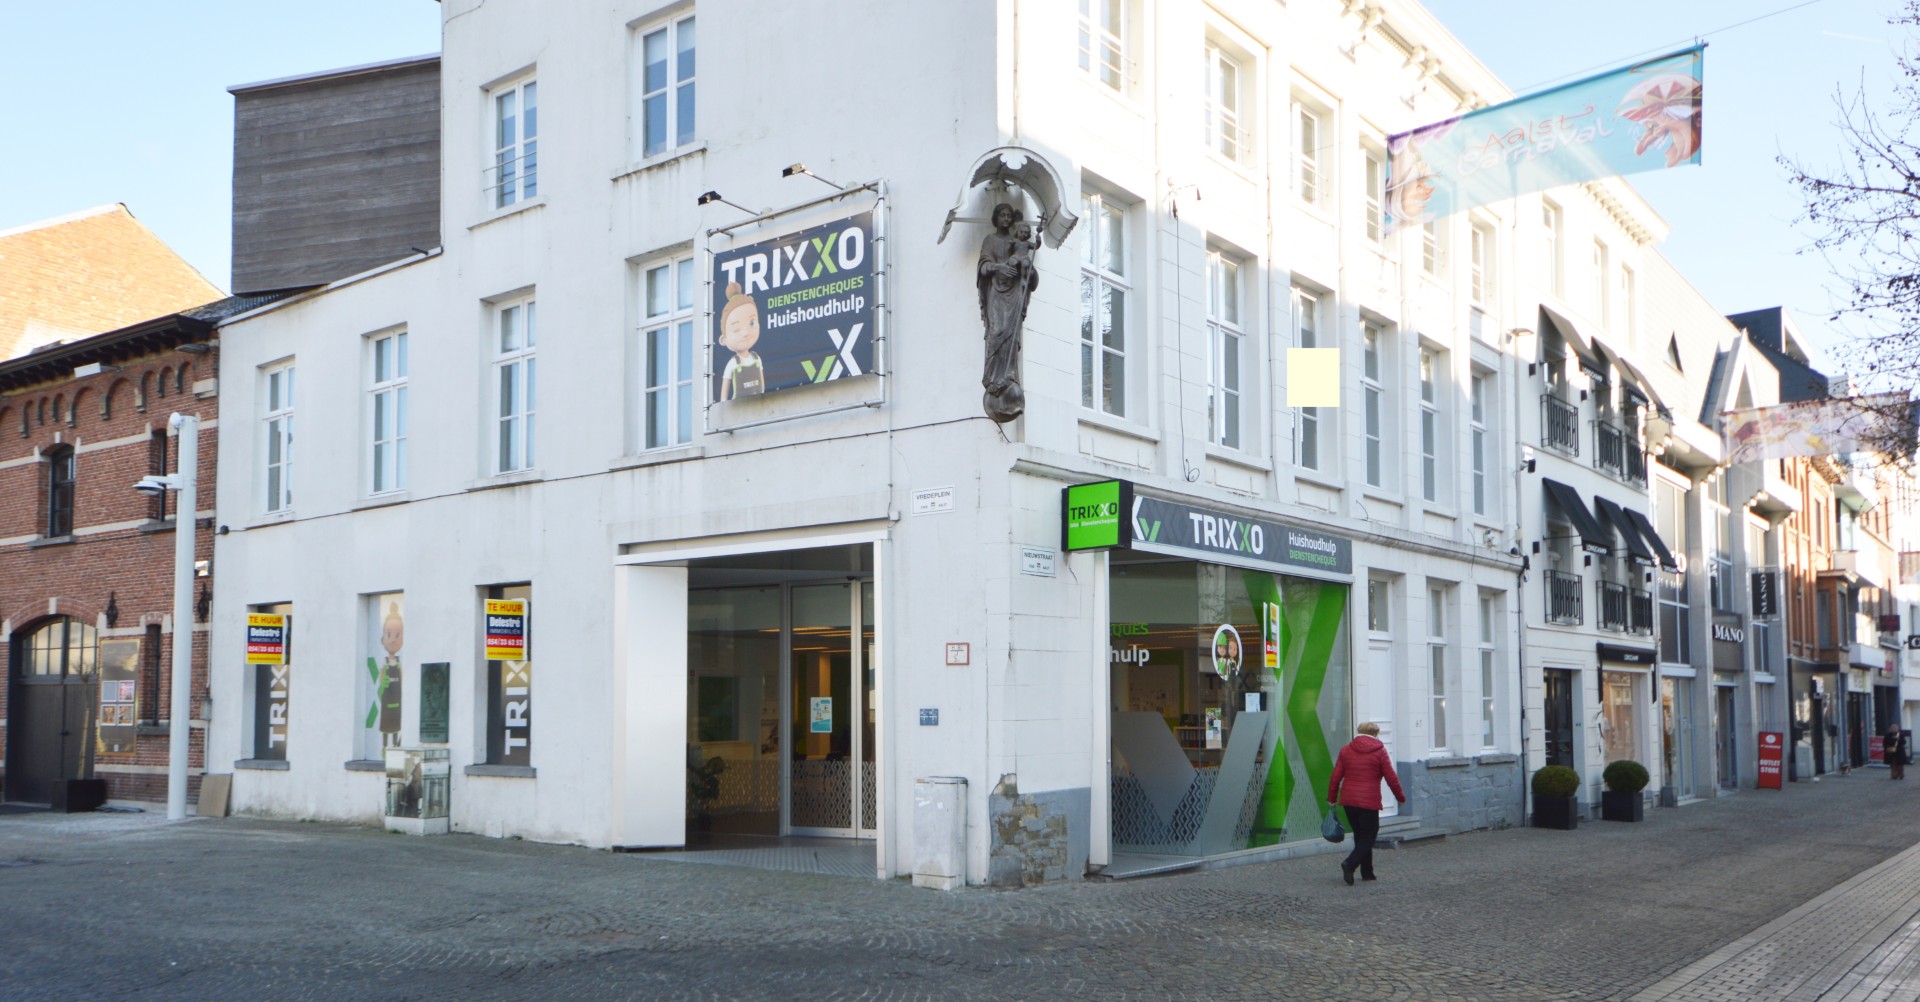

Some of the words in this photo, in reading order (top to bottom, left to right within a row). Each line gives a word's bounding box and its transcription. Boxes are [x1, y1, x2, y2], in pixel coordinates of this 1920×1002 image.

[1471, 105, 1595, 154] Aalst
[721, 226, 865, 295] TRIXXO
[767, 275, 864, 309] DIENSTENCHEQUES
[767, 294, 865, 330] Huishoudhulp
[916, 491, 951, 501] VREDEPLEIN
[1070, 502, 1118, 520] TRIXXO
[1189, 512, 1264, 555] TRIXXO
[1288, 531, 1337, 556] Huishoudhulp
[1023, 552, 1053, 561] NIEUWSTRAAT
[1289, 551, 1337, 567] DIENSTENCHEQUES
[1760, 573, 1768, 613] MANO
[488, 602, 498, 611] TE
[500, 603, 523, 613] HUUR
[249, 616, 258, 624] TE
[261, 616, 282, 624] HUUR
[489, 616, 521, 628] Delestré
[1714, 624, 1744, 643] MANO
